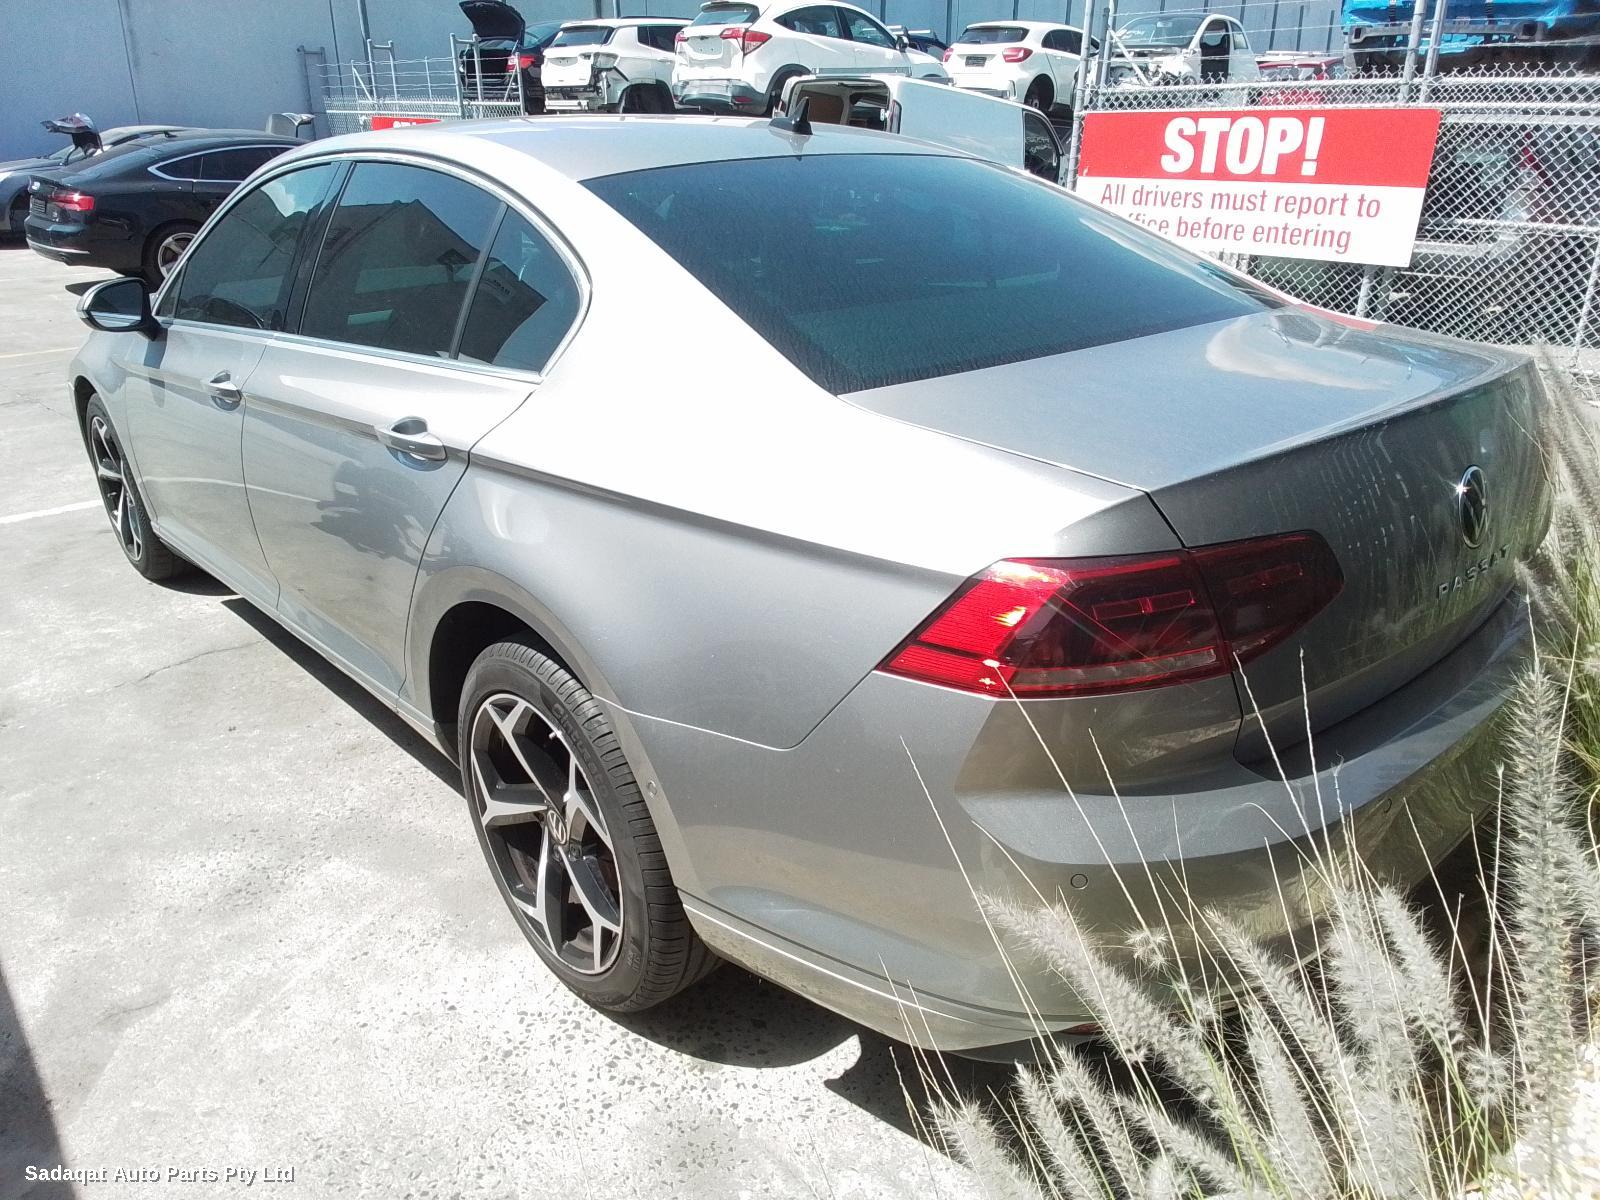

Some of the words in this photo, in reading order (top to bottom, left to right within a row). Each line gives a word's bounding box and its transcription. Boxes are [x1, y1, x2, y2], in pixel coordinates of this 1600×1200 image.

[1160, 116, 1326, 176] STOP!
[1100, 183, 1126, 205] All
[1132, 184, 1203, 209] drivers
[1210, 188, 1268, 213] must
[1273, 190, 1349, 220] report
[1356, 193, 1381, 218] to
[1176, 215, 1246, 242] before
[1252, 221, 1352, 255] entering
[1437, 544, 1510, 602] PASSAT
